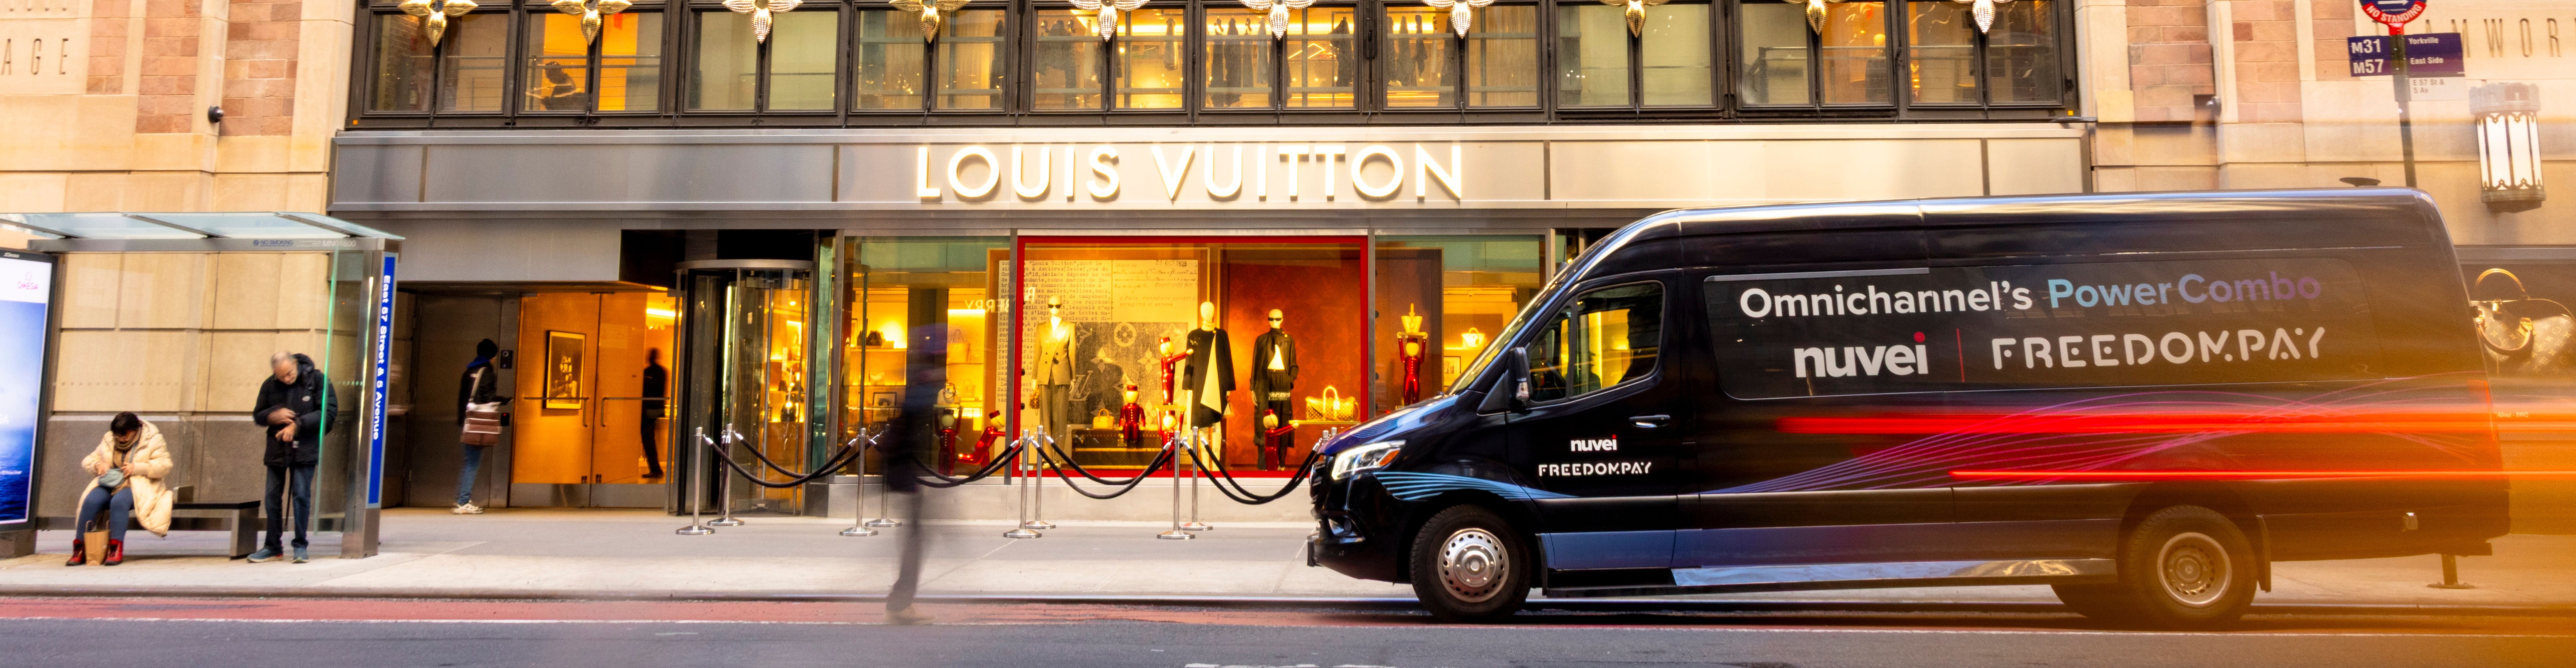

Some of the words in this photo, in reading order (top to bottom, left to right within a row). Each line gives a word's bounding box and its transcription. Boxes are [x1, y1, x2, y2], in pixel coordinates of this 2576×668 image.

[2366, 5, 2380, 17] NO
[2380, 4, 2423, 23] STANDING
[2351, 39, 2381, 54] M31
[2353, 59, 2384, 74] M57
[917, 145, 1120, 199] LOUIS
[1151, 145, 1461, 200] VUITTON
[382, 275, 391, 303] East
[1740, 279, 2032, 319] Omnichannel's
[2050, 277, 2170, 309] Power
[2177, 271, 2321, 303] Combo
[378, 325, 387, 364] Street
[1794, 331, 1929, 378] nuvei
[1991, 327, 2326, 371] FREEDOMPAY
[373, 391, 383, 440] Avenue
[1571, 434, 1618, 452] nuvei
[1539, 462, 1652, 476] FREEDOMPAY
